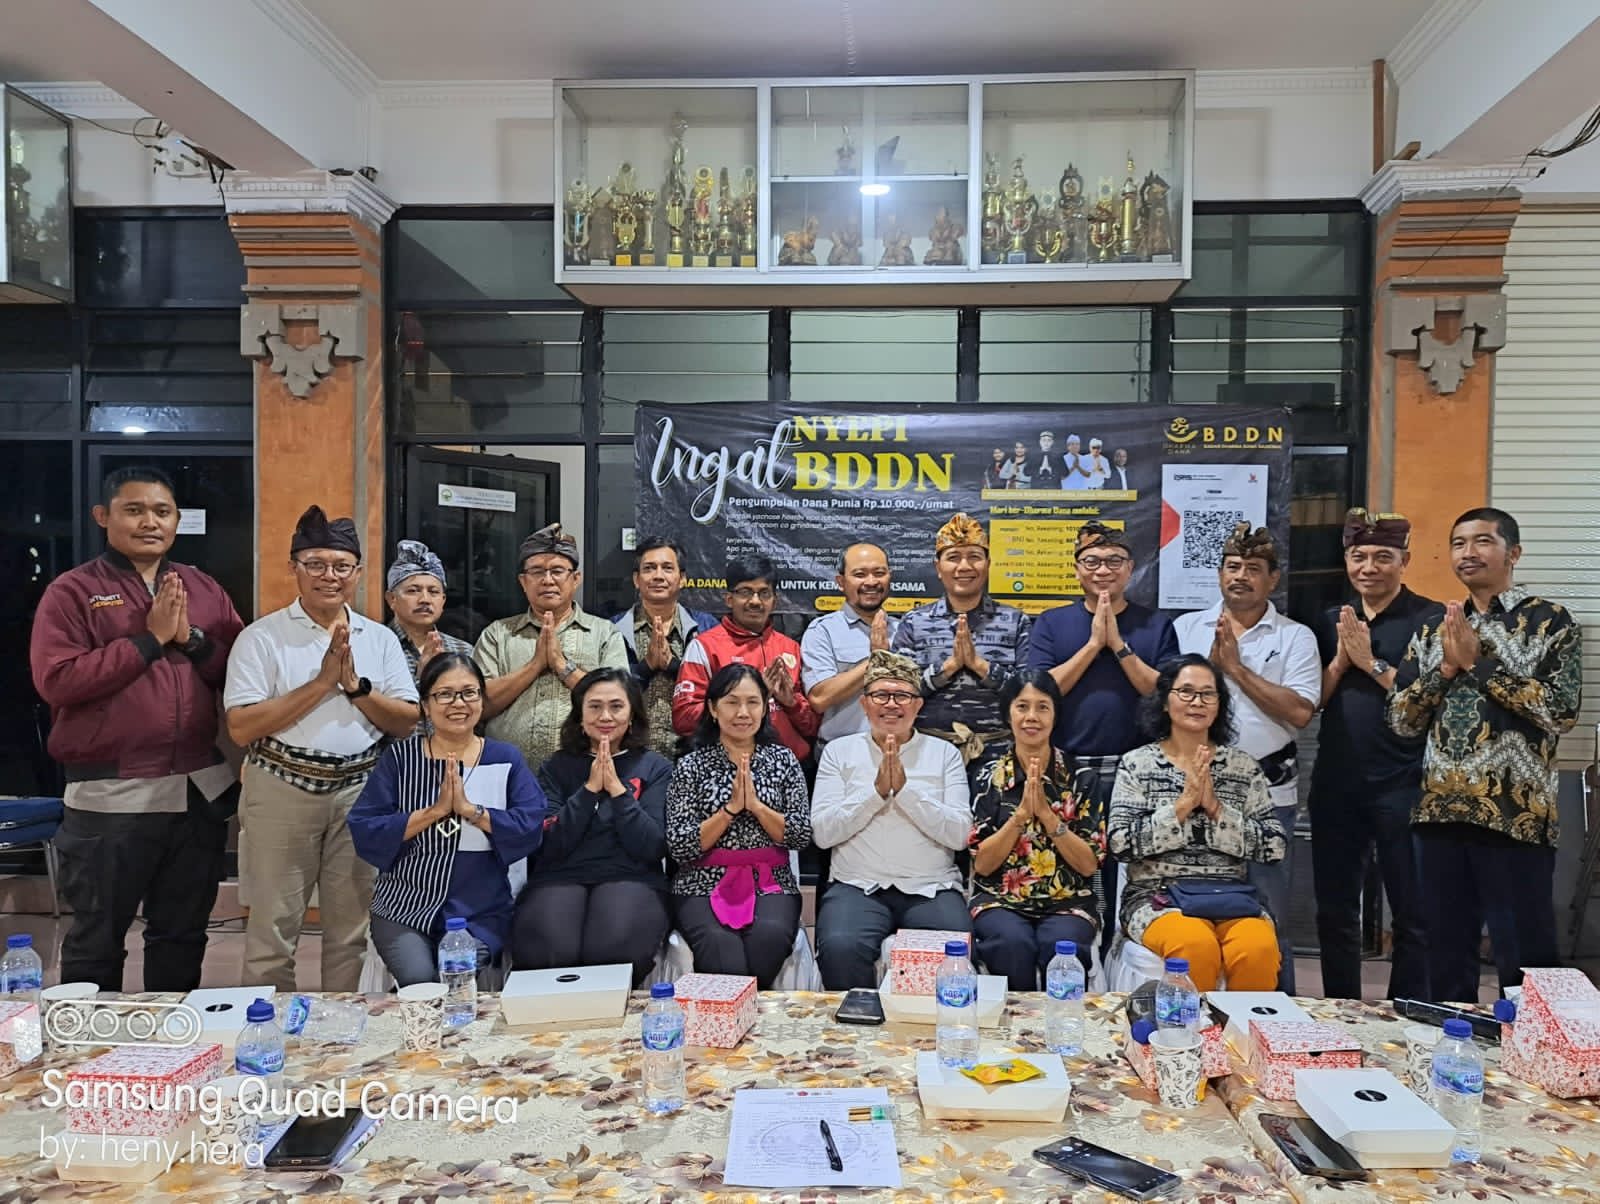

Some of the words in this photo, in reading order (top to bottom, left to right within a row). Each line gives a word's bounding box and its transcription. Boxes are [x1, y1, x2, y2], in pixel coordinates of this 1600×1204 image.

[793, 415, 908, 442] NYEPI
[651, 416, 804, 525] Ingat
[792, 452, 955, 491] BDDN
[728, 496, 800, 508] Pengumpulan
[802, 498, 828, 508] Dana
[831, 498, 861, 508] Punia
[697, 579, 728, 588] DANA
[780, 580, 816, 589] UNTUK
